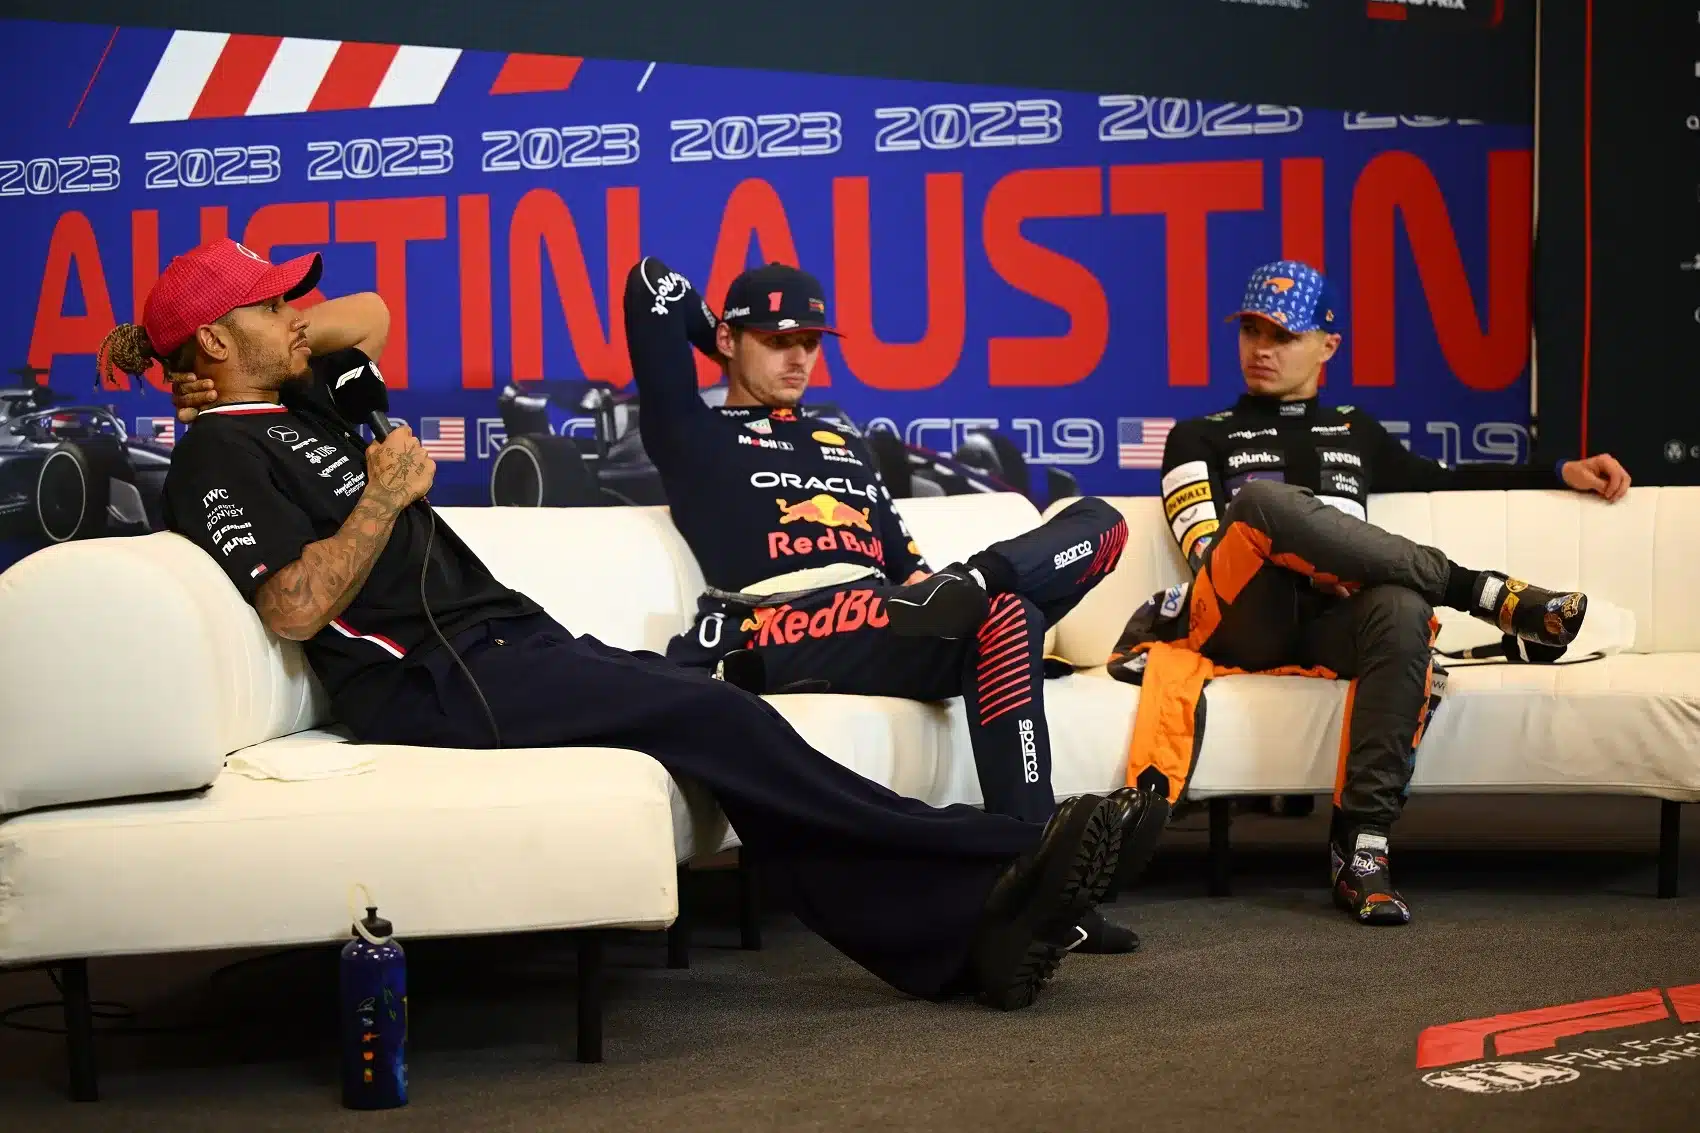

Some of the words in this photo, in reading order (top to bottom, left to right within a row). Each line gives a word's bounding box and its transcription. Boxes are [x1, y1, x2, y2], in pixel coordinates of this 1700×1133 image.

[0, 155, 120, 196] 2023
[145, 145, 281, 189] 2023
[307, 135, 454, 181] 2023
[482, 123, 640, 172] 2023
[670, 111, 842, 163] 2023
[875, 99, 1062, 152] 2023
[693, 150, 1534, 391] AUSTIN
[768, 292, 783, 311] 1
[738, 434, 778, 449] Mobil
[1012, 418, 1104, 465] 19
[202, 488, 229, 508] IWC
[750, 471, 877, 503] ORACLE
[207, 504, 236, 519] MARRIOTT
[222, 532, 257, 557] nuvei
[768, 528, 838, 560] Red
[1054, 540, 1093, 570] sparco
[1019, 718, 1039, 783] sparco
[1544, 1047, 1628, 1065] FIA
